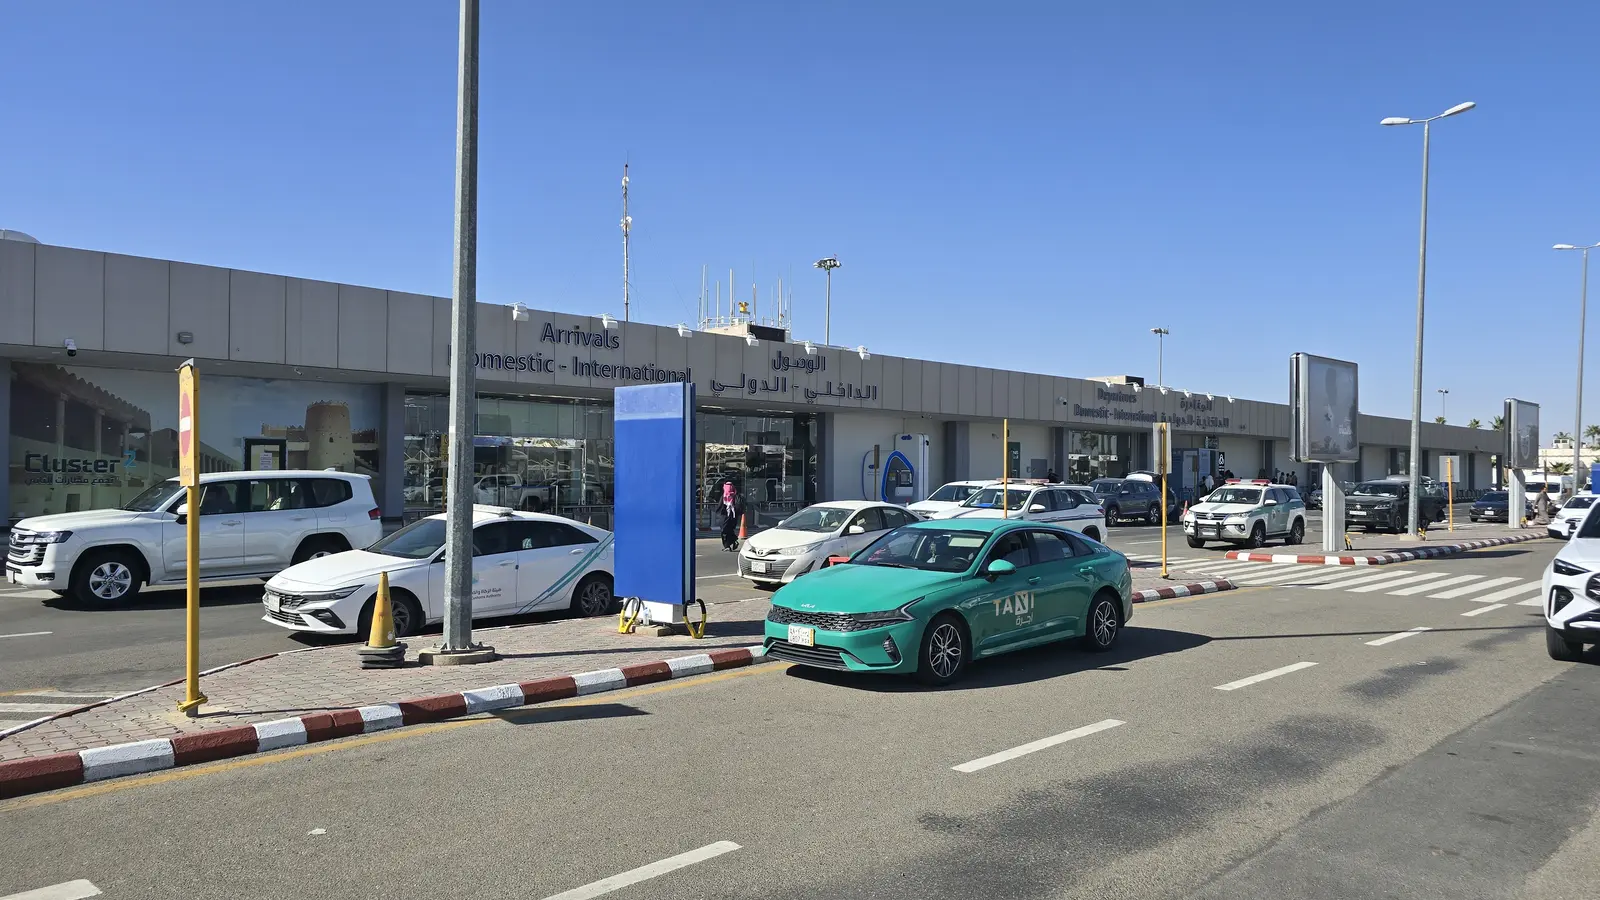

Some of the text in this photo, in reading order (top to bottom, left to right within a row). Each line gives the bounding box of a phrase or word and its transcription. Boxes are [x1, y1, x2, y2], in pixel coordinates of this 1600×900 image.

[541, 322, 620, 349] Arrivals
[448, 344, 554, 373] mestic
[572, 356, 692, 383] International
[772, 351, 826, 374] الوصول
[710, 373, 787, 398] الدولي
[804, 381, 877, 404] الداخلي
[1074, 404, 1110, 420] Domestic
[25, 453, 120, 473] Cluster
[992, 590, 1035, 616] TAXI
